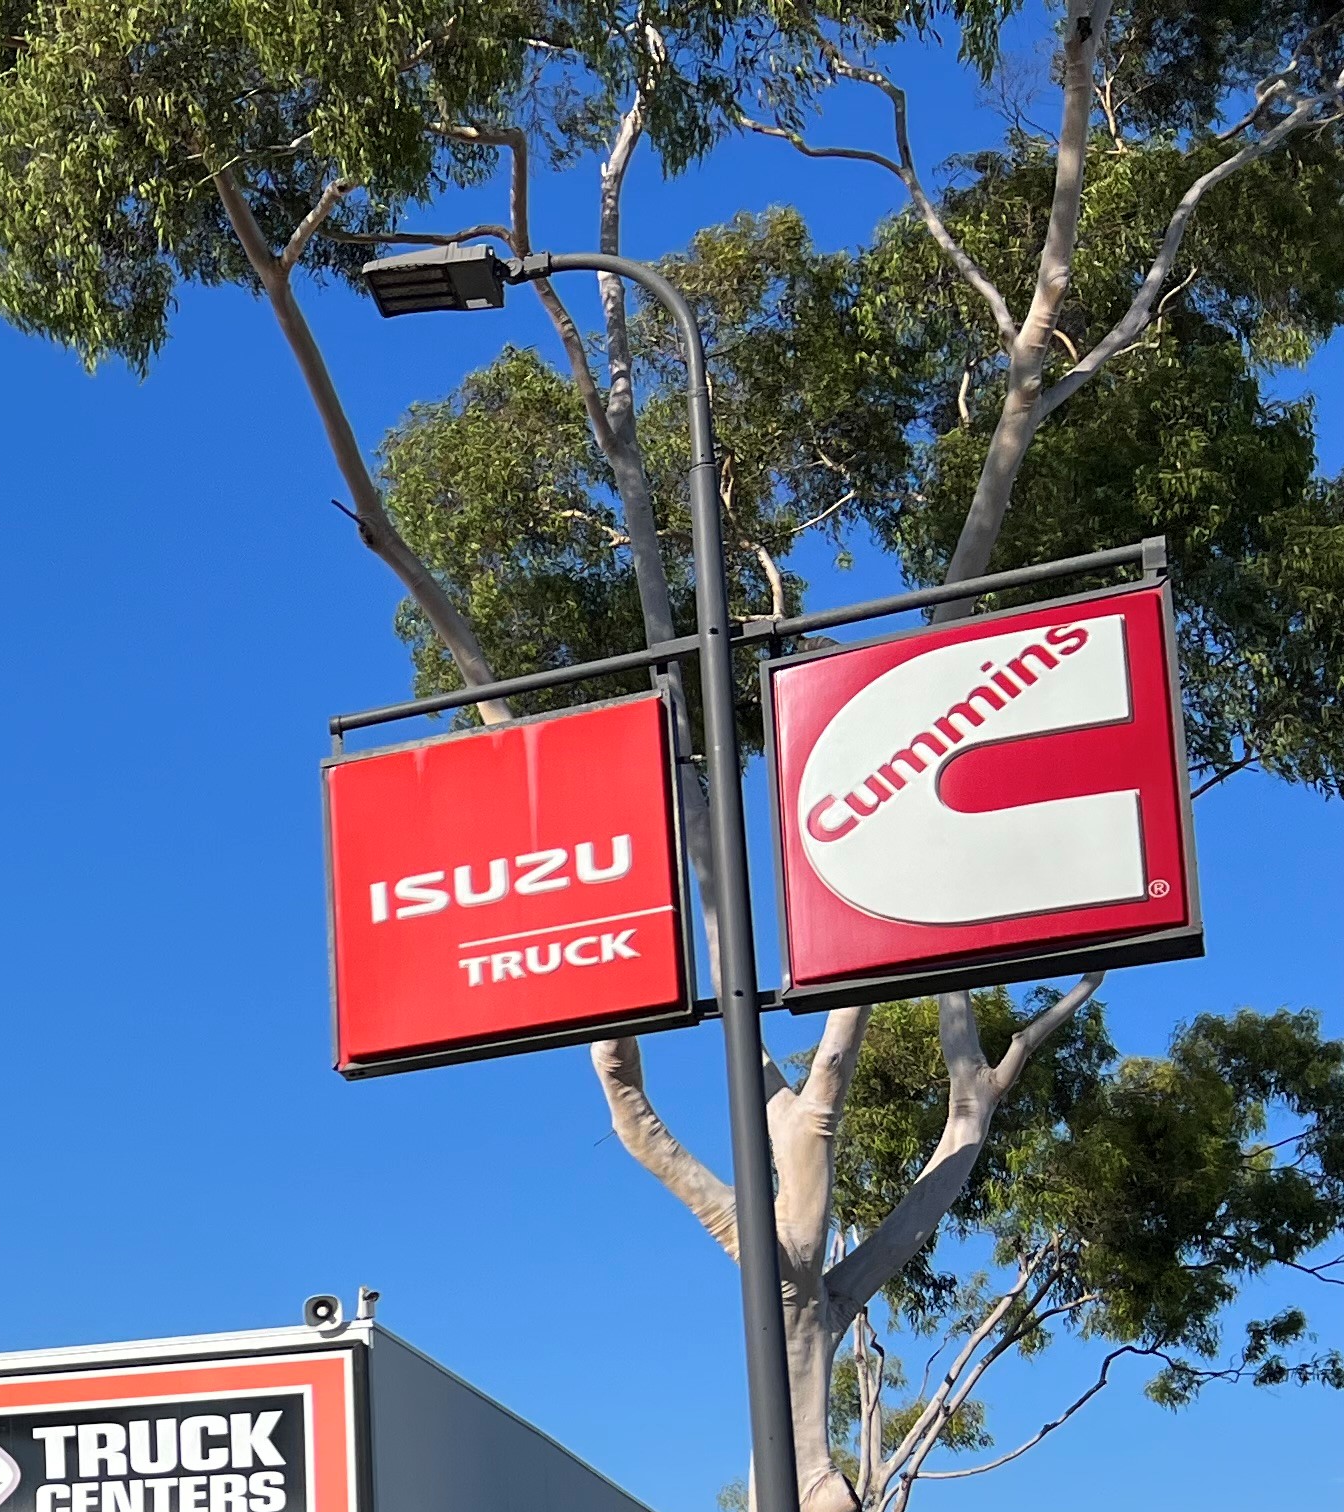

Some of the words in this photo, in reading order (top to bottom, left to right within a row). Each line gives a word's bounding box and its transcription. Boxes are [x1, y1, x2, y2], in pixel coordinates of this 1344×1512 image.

[807, 621, 1091, 843] Cummins
[369, 833, 633, 923] ISUZU
[458, 928, 641, 987] TRUCK
[33, 1410, 285, 1480] TRUCK
